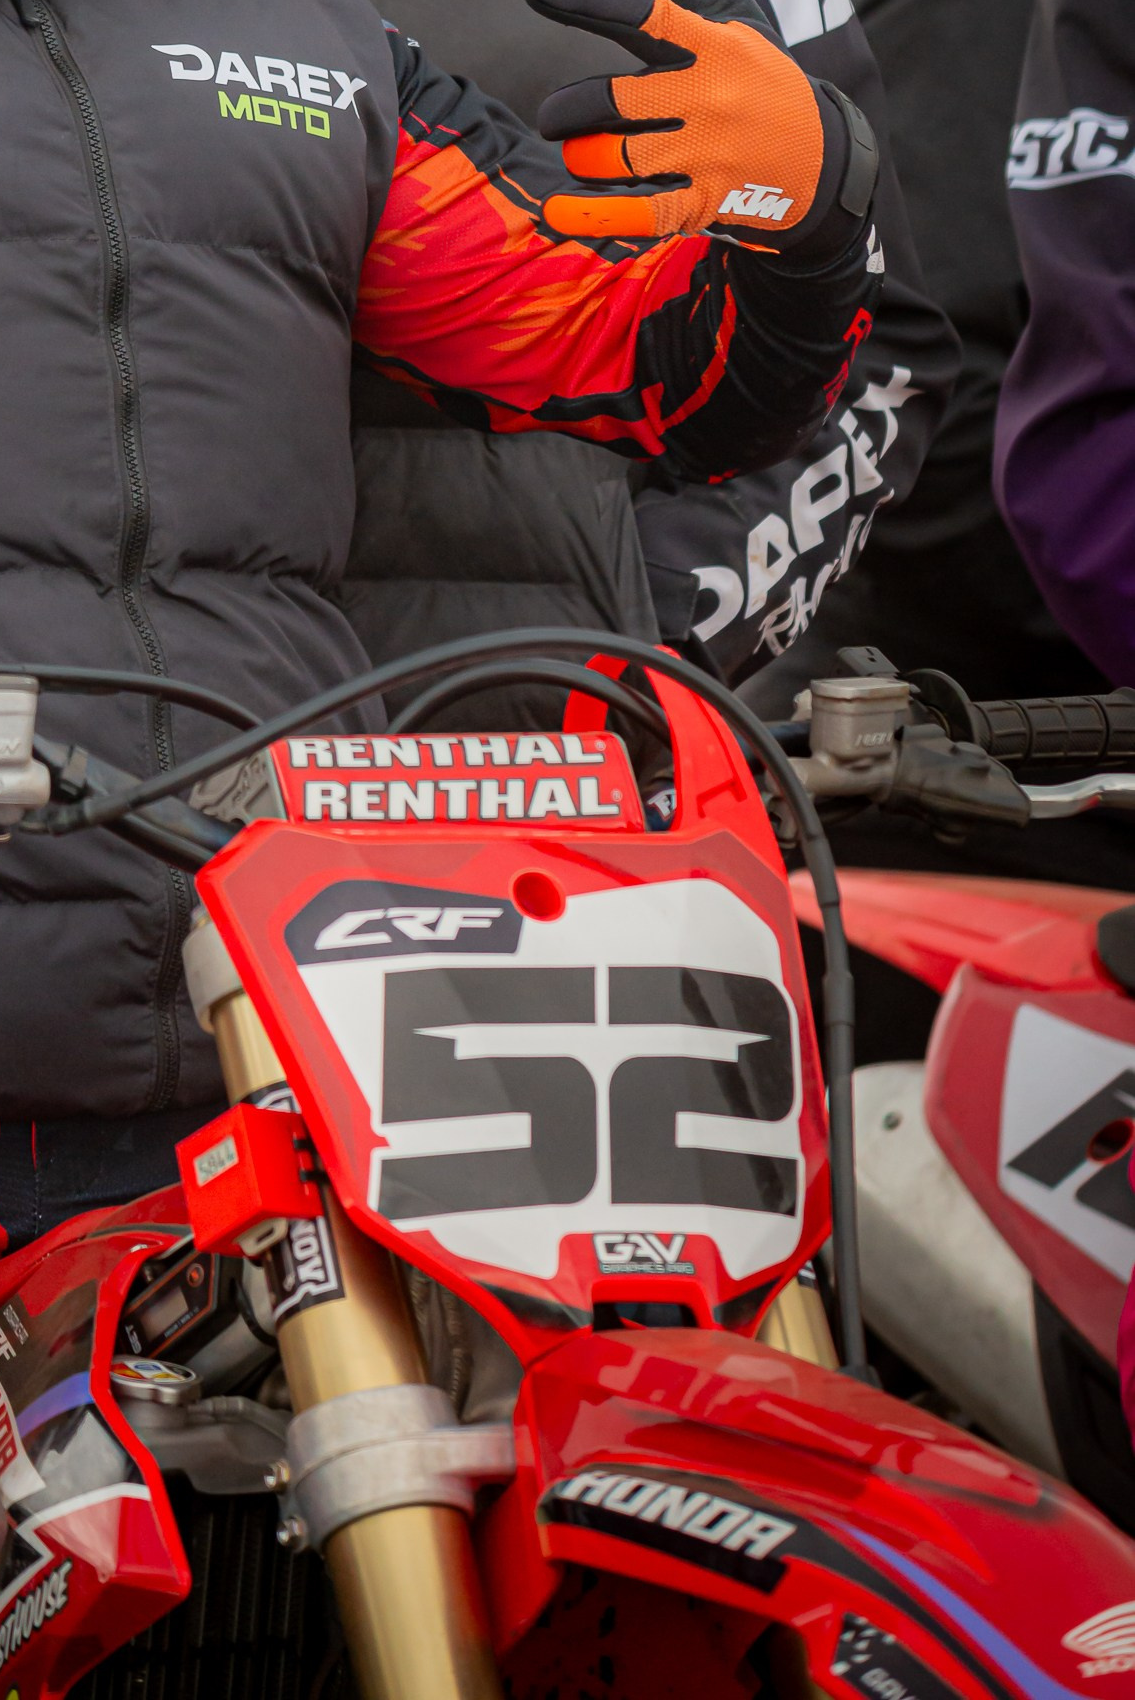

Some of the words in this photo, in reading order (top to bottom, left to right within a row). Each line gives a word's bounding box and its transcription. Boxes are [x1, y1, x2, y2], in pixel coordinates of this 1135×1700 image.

[151, 43, 368, 119] DAREX
[218, 91, 331, 139] MOTO
[717, 183, 795, 221] KTM
[288, 734, 606, 768] RENTHAL
[304, 776, 621, 821] RENTHAL
[314, 906, 504, 950] CRF
[377, 966, 798, 1220] 52
[592, 1232, 686, 1264] GAV
[556, 1470, 798, 1561] HONDA
